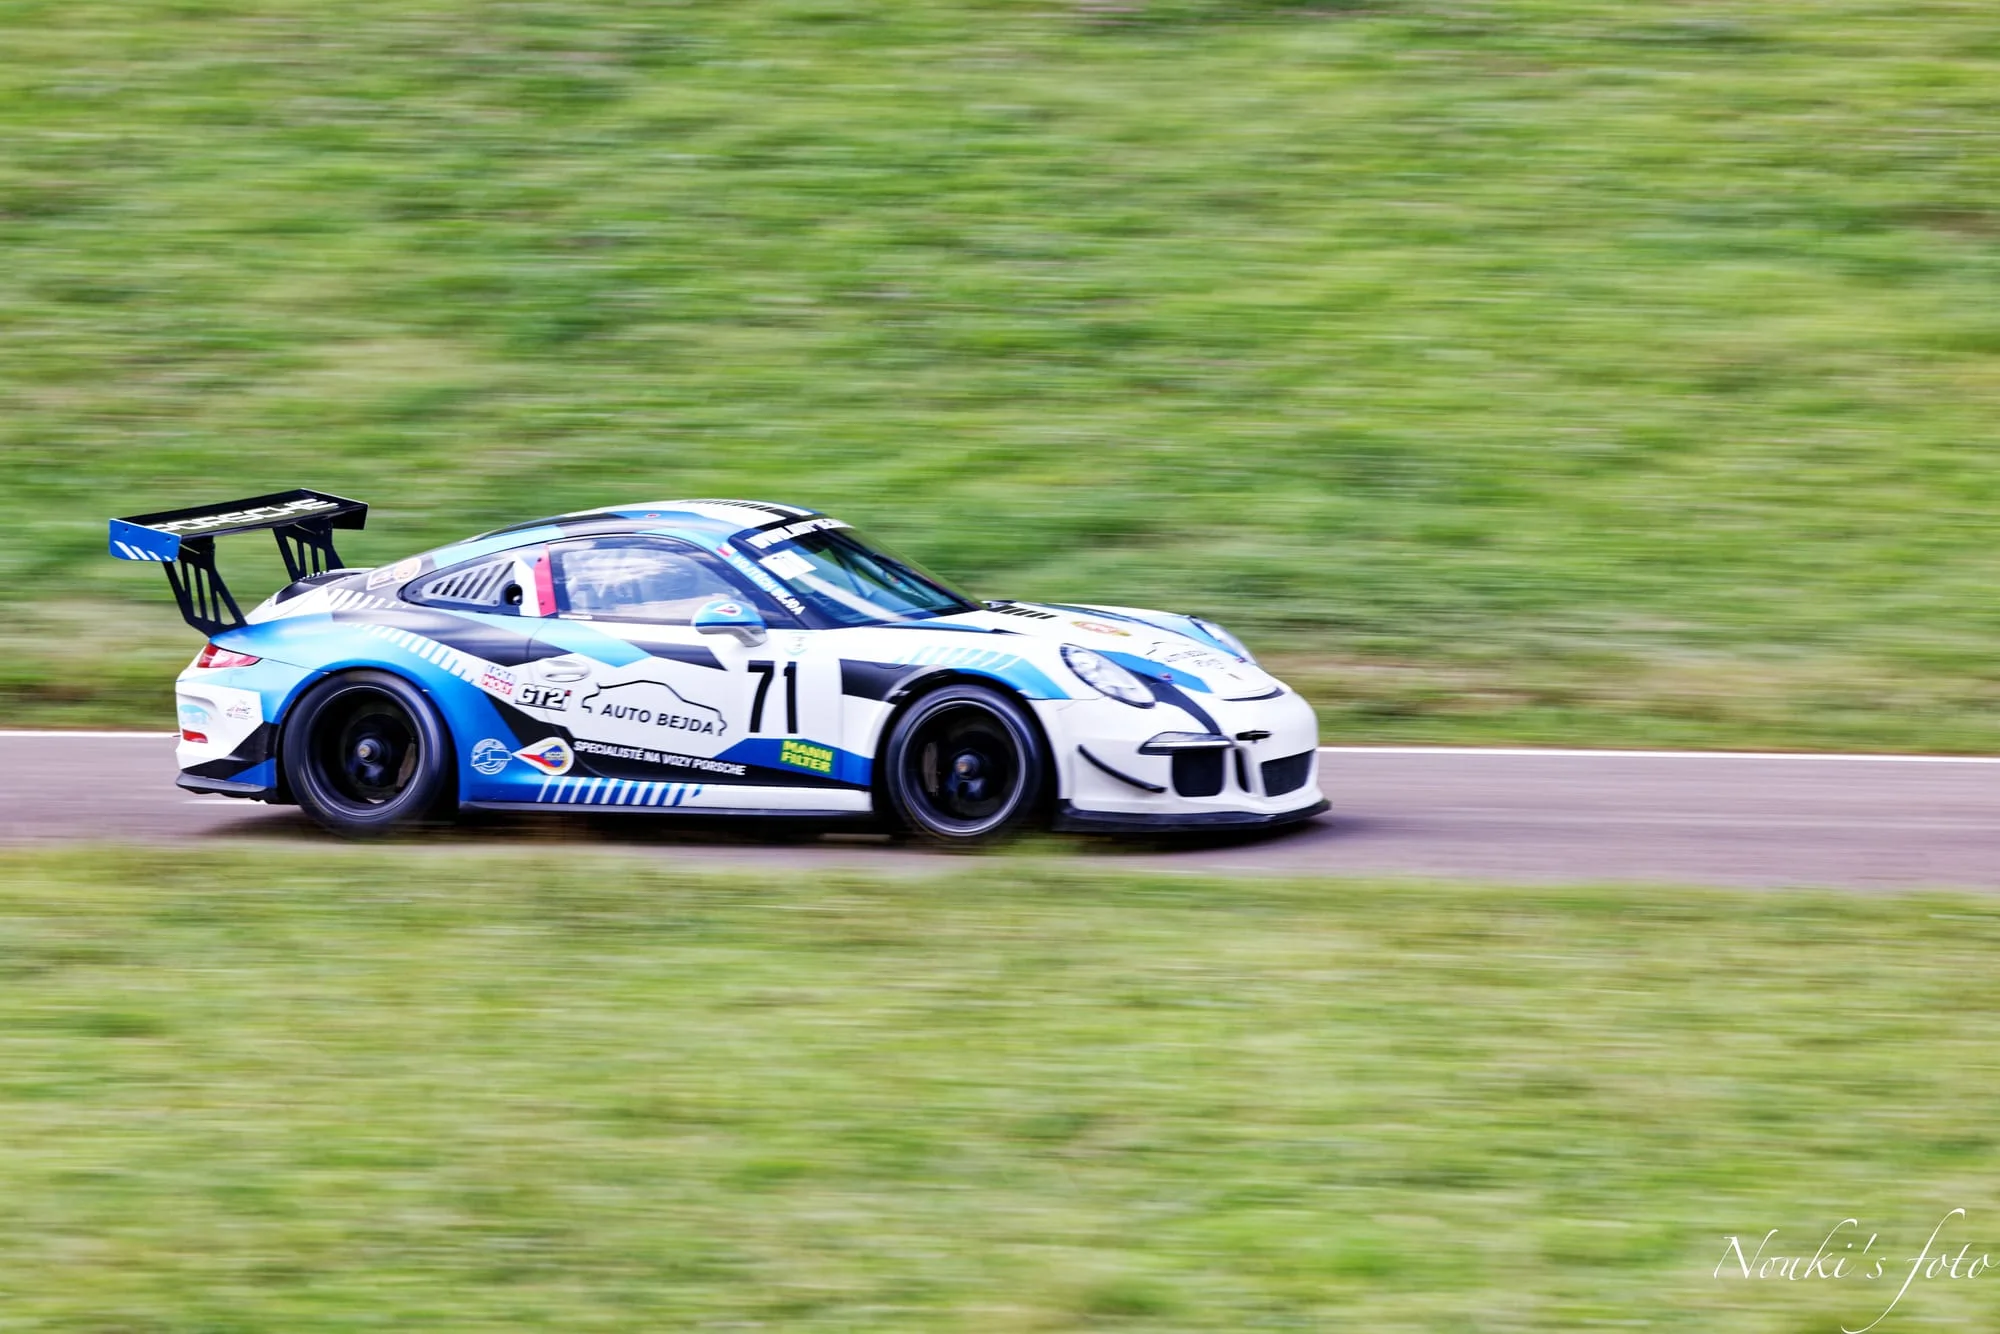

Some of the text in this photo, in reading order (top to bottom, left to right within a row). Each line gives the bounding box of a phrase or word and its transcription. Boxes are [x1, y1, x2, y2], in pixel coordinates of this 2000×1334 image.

[747, 659, 798, 734] 71
[600, 703, 714, 735] AUTO BEJDA
[573, 740, 643, 761] SPECIALISTÉ
[643, 750, 661, 764] NA
[661, 754, 691, 768] VOZY
[690, 757, 748, 776] PORSCHE
[782, 740, 833, 762] MANN
